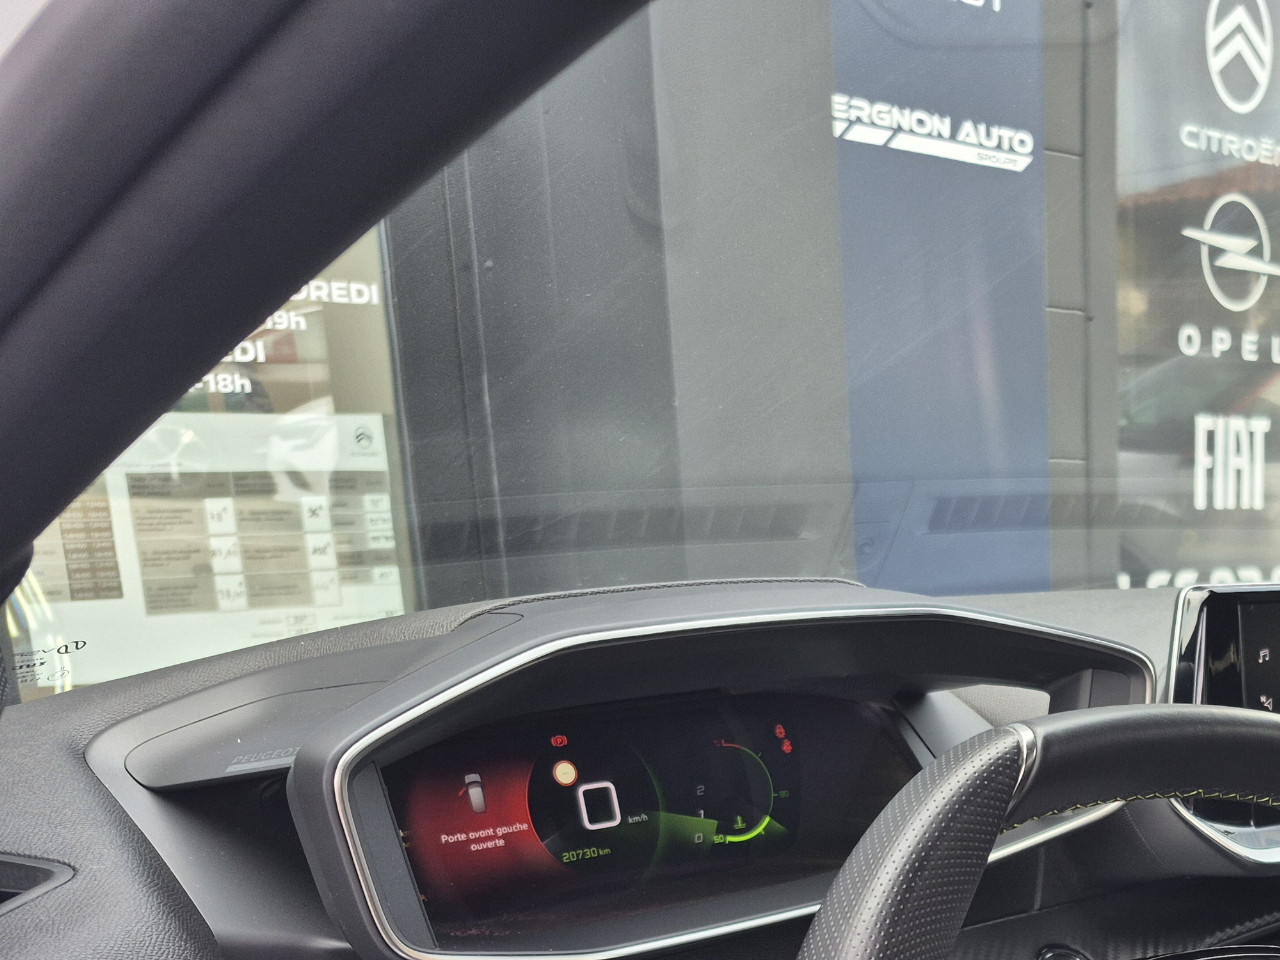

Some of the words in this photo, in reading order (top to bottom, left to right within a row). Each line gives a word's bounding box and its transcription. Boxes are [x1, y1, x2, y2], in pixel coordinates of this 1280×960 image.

[955, 119, 1034, 154] AUTO
[1193, 414, 1271, 511] FIAT
[231, 747, 301, 764] PEUGEOT
[628, 813, 649, 824] km/h
[441, 832, 467, 844] Porte
[469, 828, 495, 840] avant
[496, 822, 529, 836] gauche
[470, 838, 505, 851] ouverte
[562, 847, 598, 863] 20730
[598, 847, 611, 856] km
